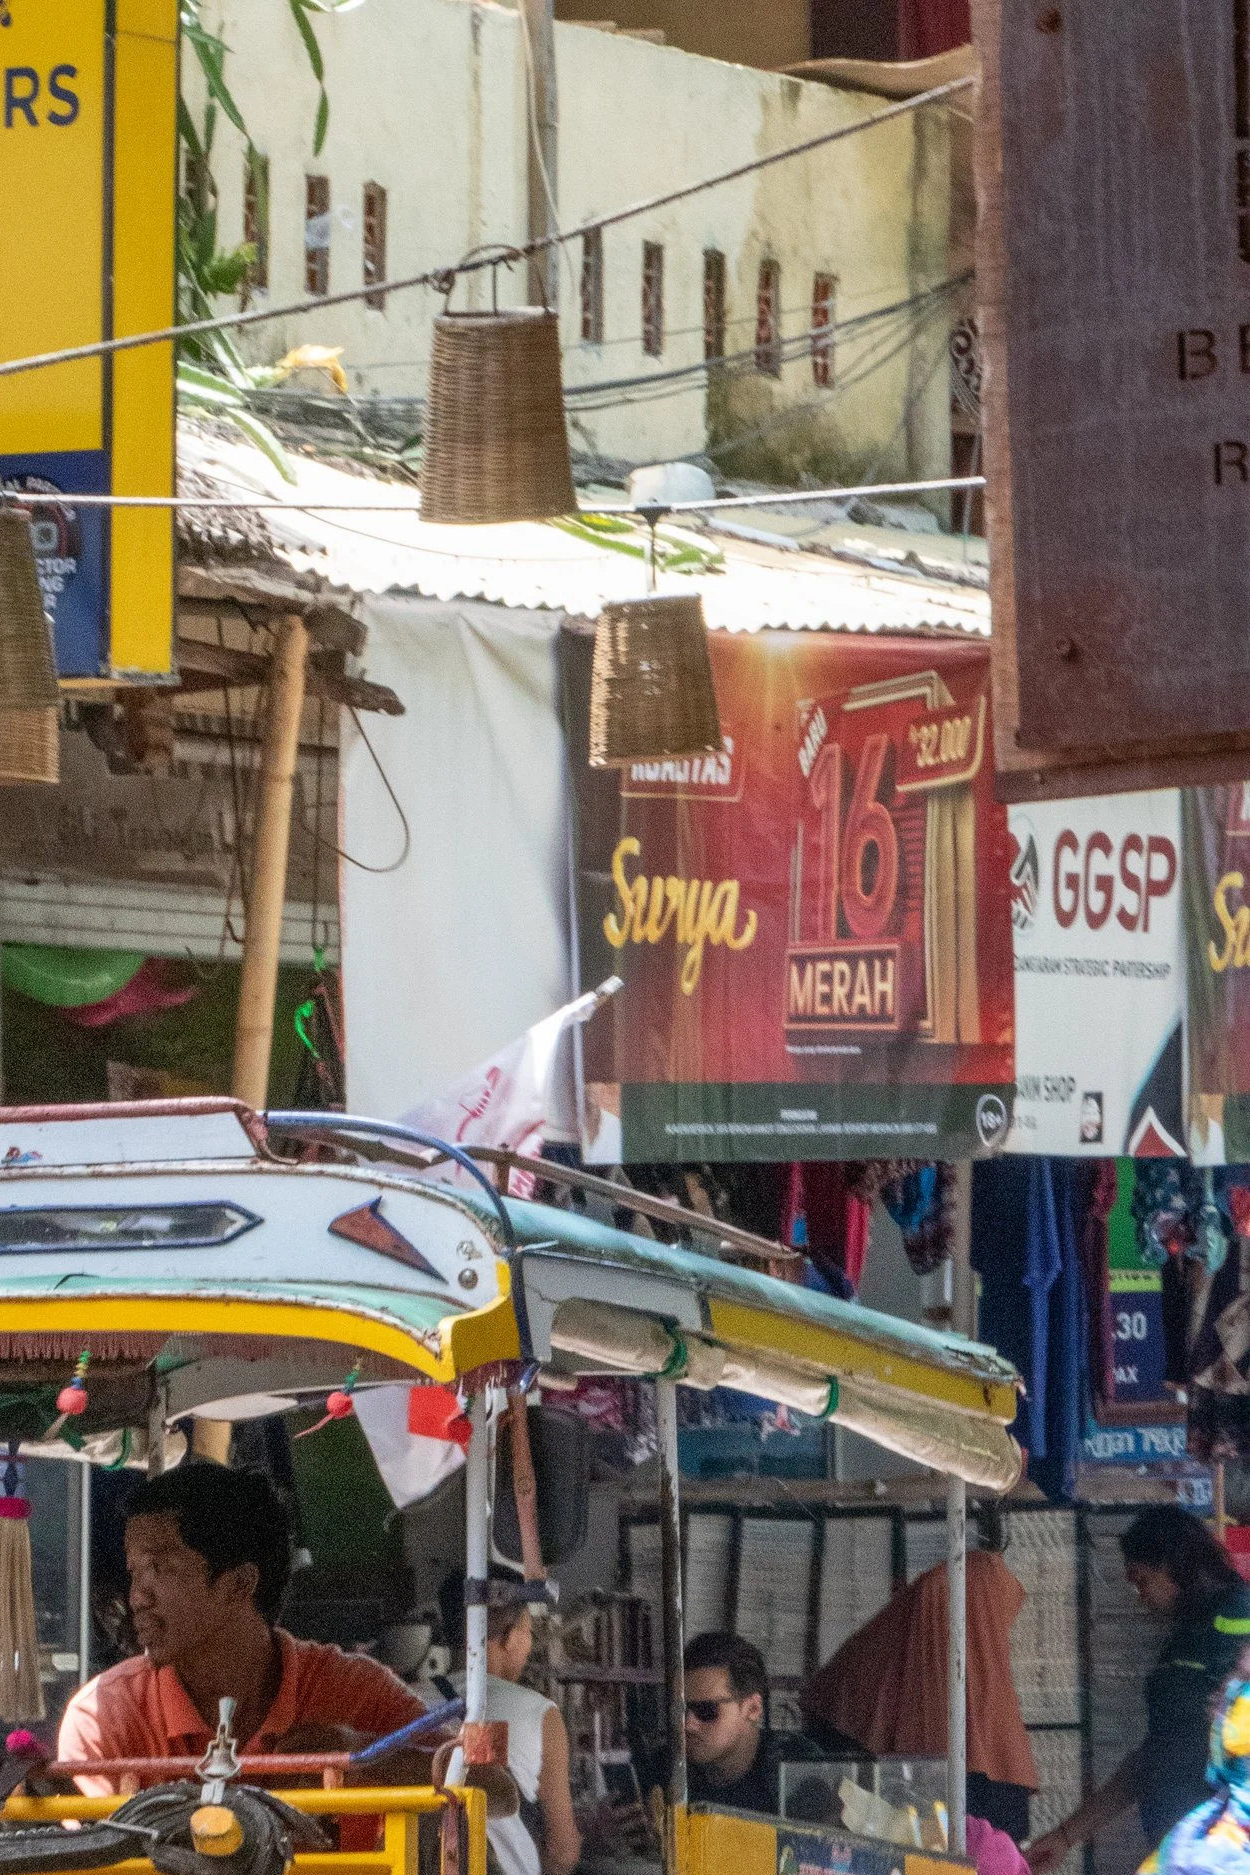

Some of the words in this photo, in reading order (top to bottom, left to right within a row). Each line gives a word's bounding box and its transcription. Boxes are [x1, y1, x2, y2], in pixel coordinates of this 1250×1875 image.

[810, 733, 900, 941] 16
[1053, 828, 1178, 934] GGSP
[603, 837, 759, 996] Surya
[789, 959, 895, 1015] MERAH
